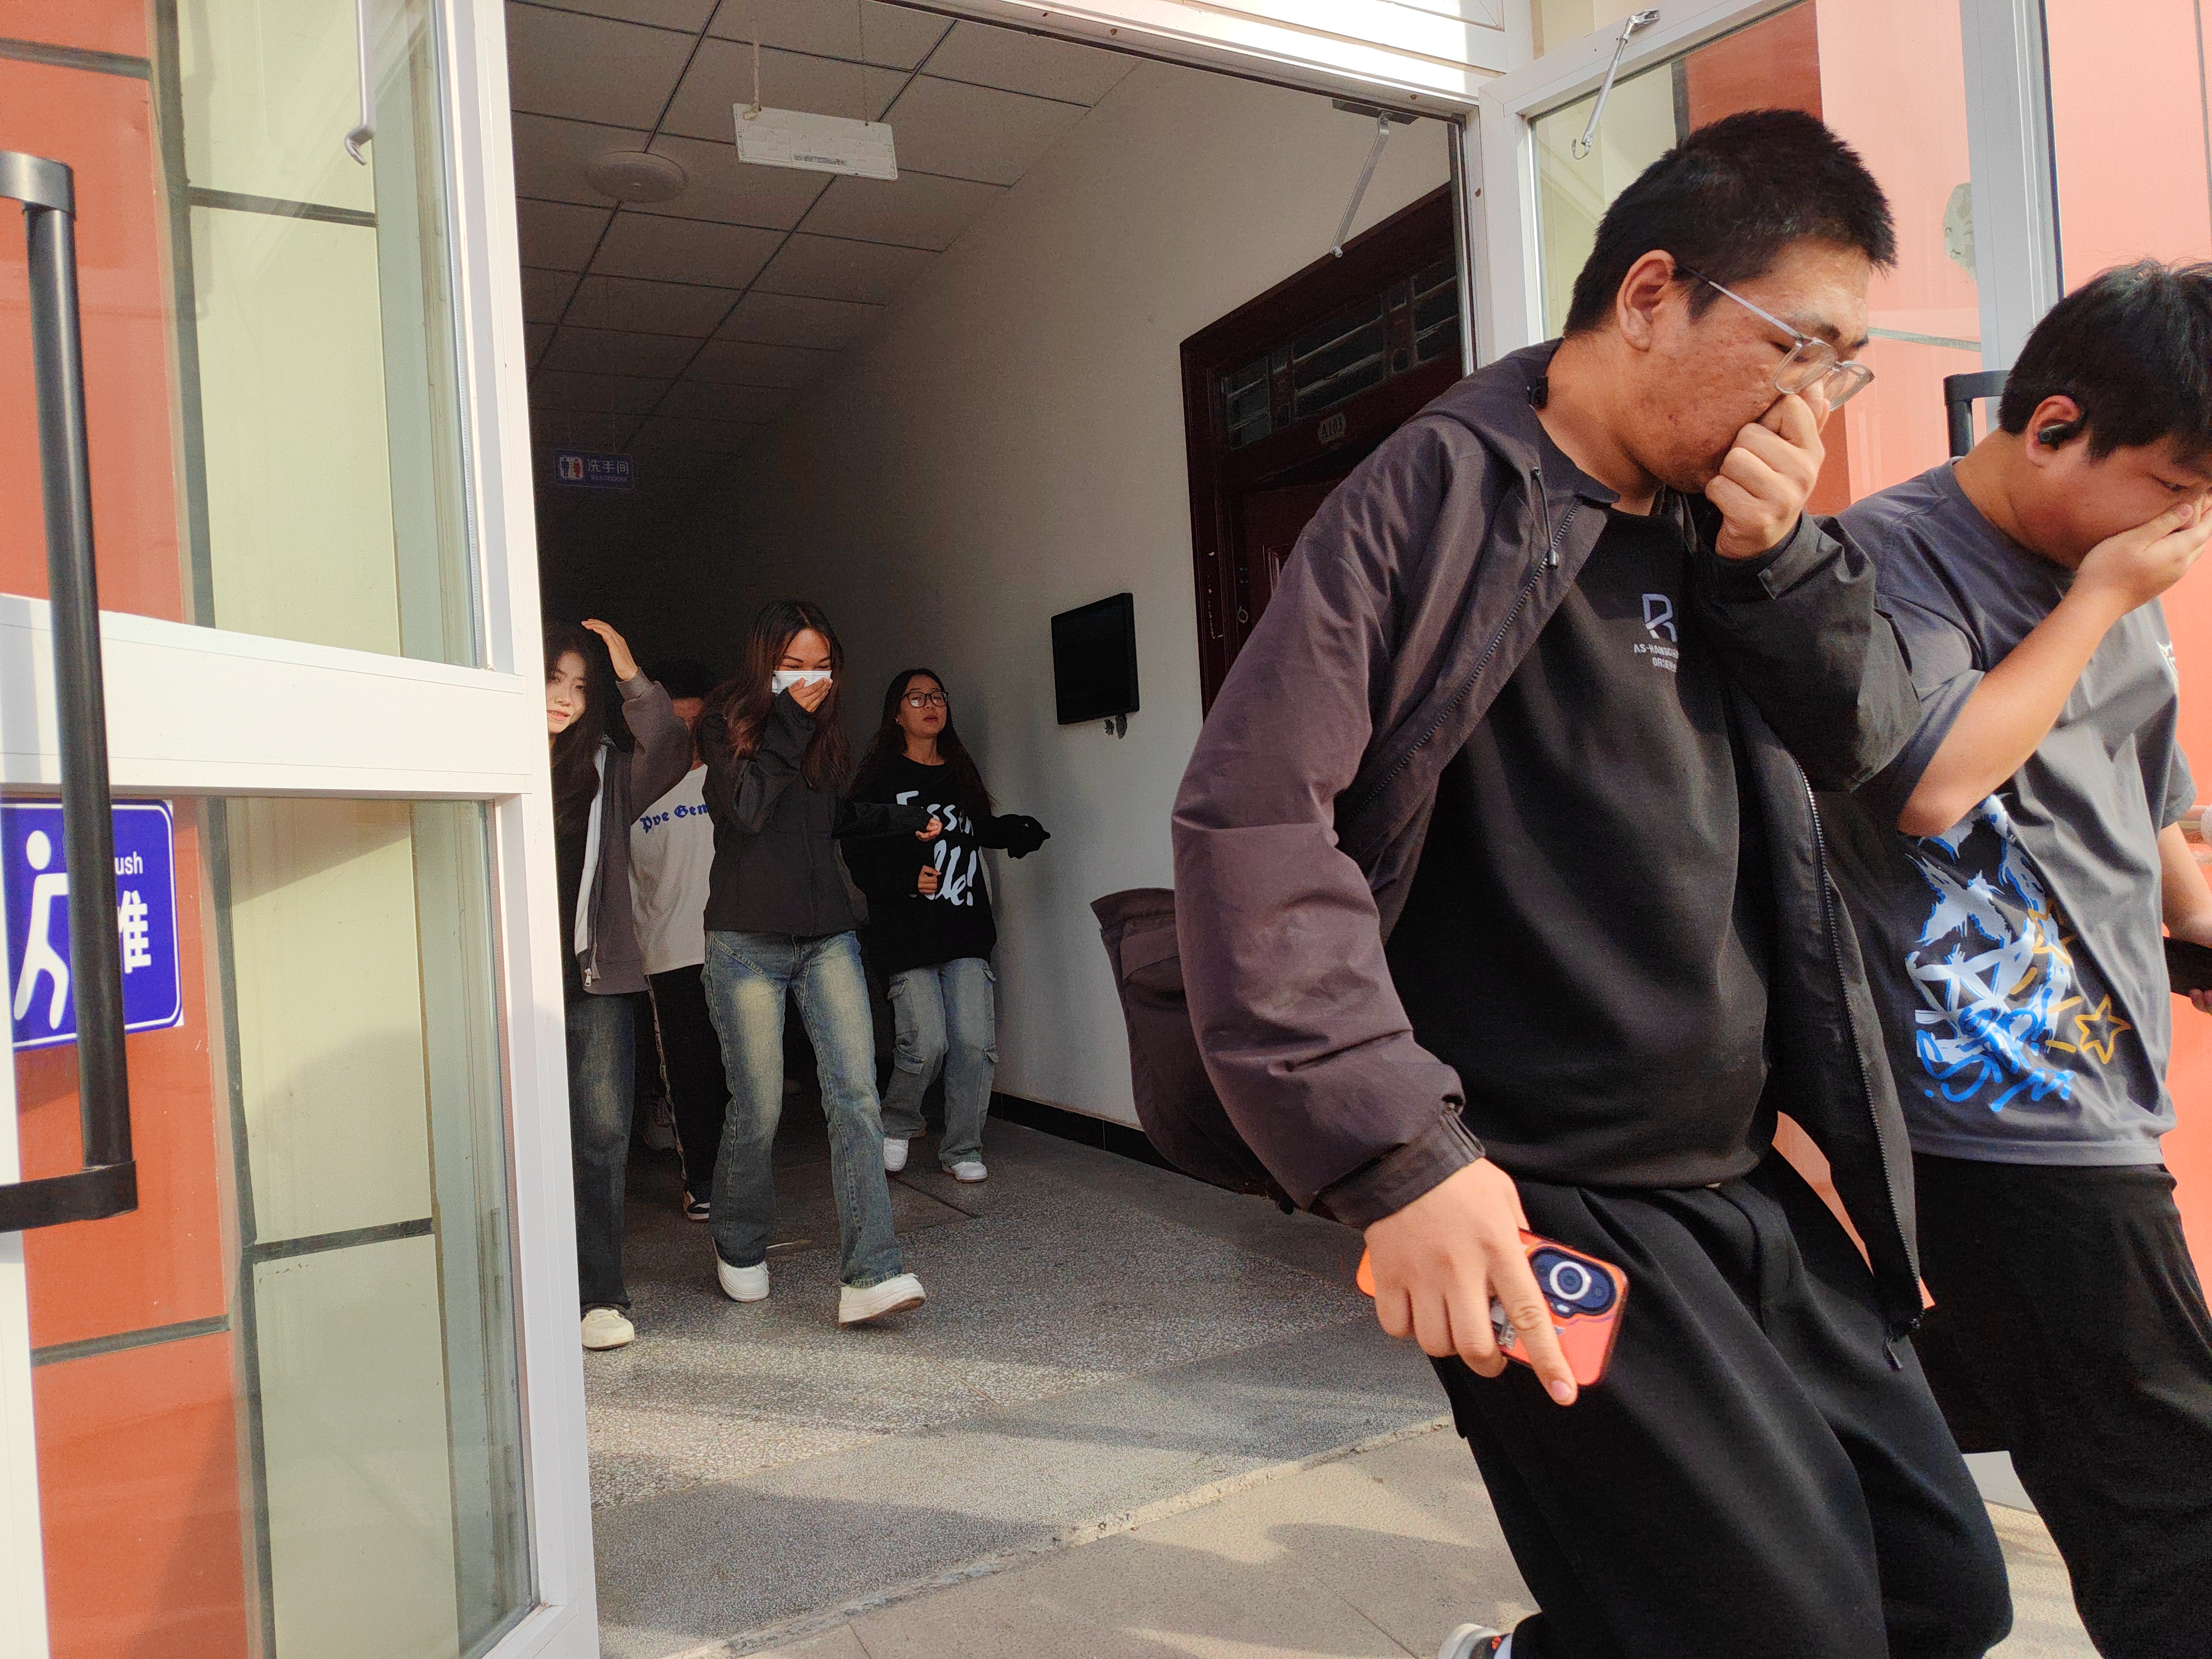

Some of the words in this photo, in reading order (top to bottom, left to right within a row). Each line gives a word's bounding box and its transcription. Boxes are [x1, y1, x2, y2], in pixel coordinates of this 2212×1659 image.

[587, 458, 629, 474] 洗手间
[114, 851, 143, 875] ush
